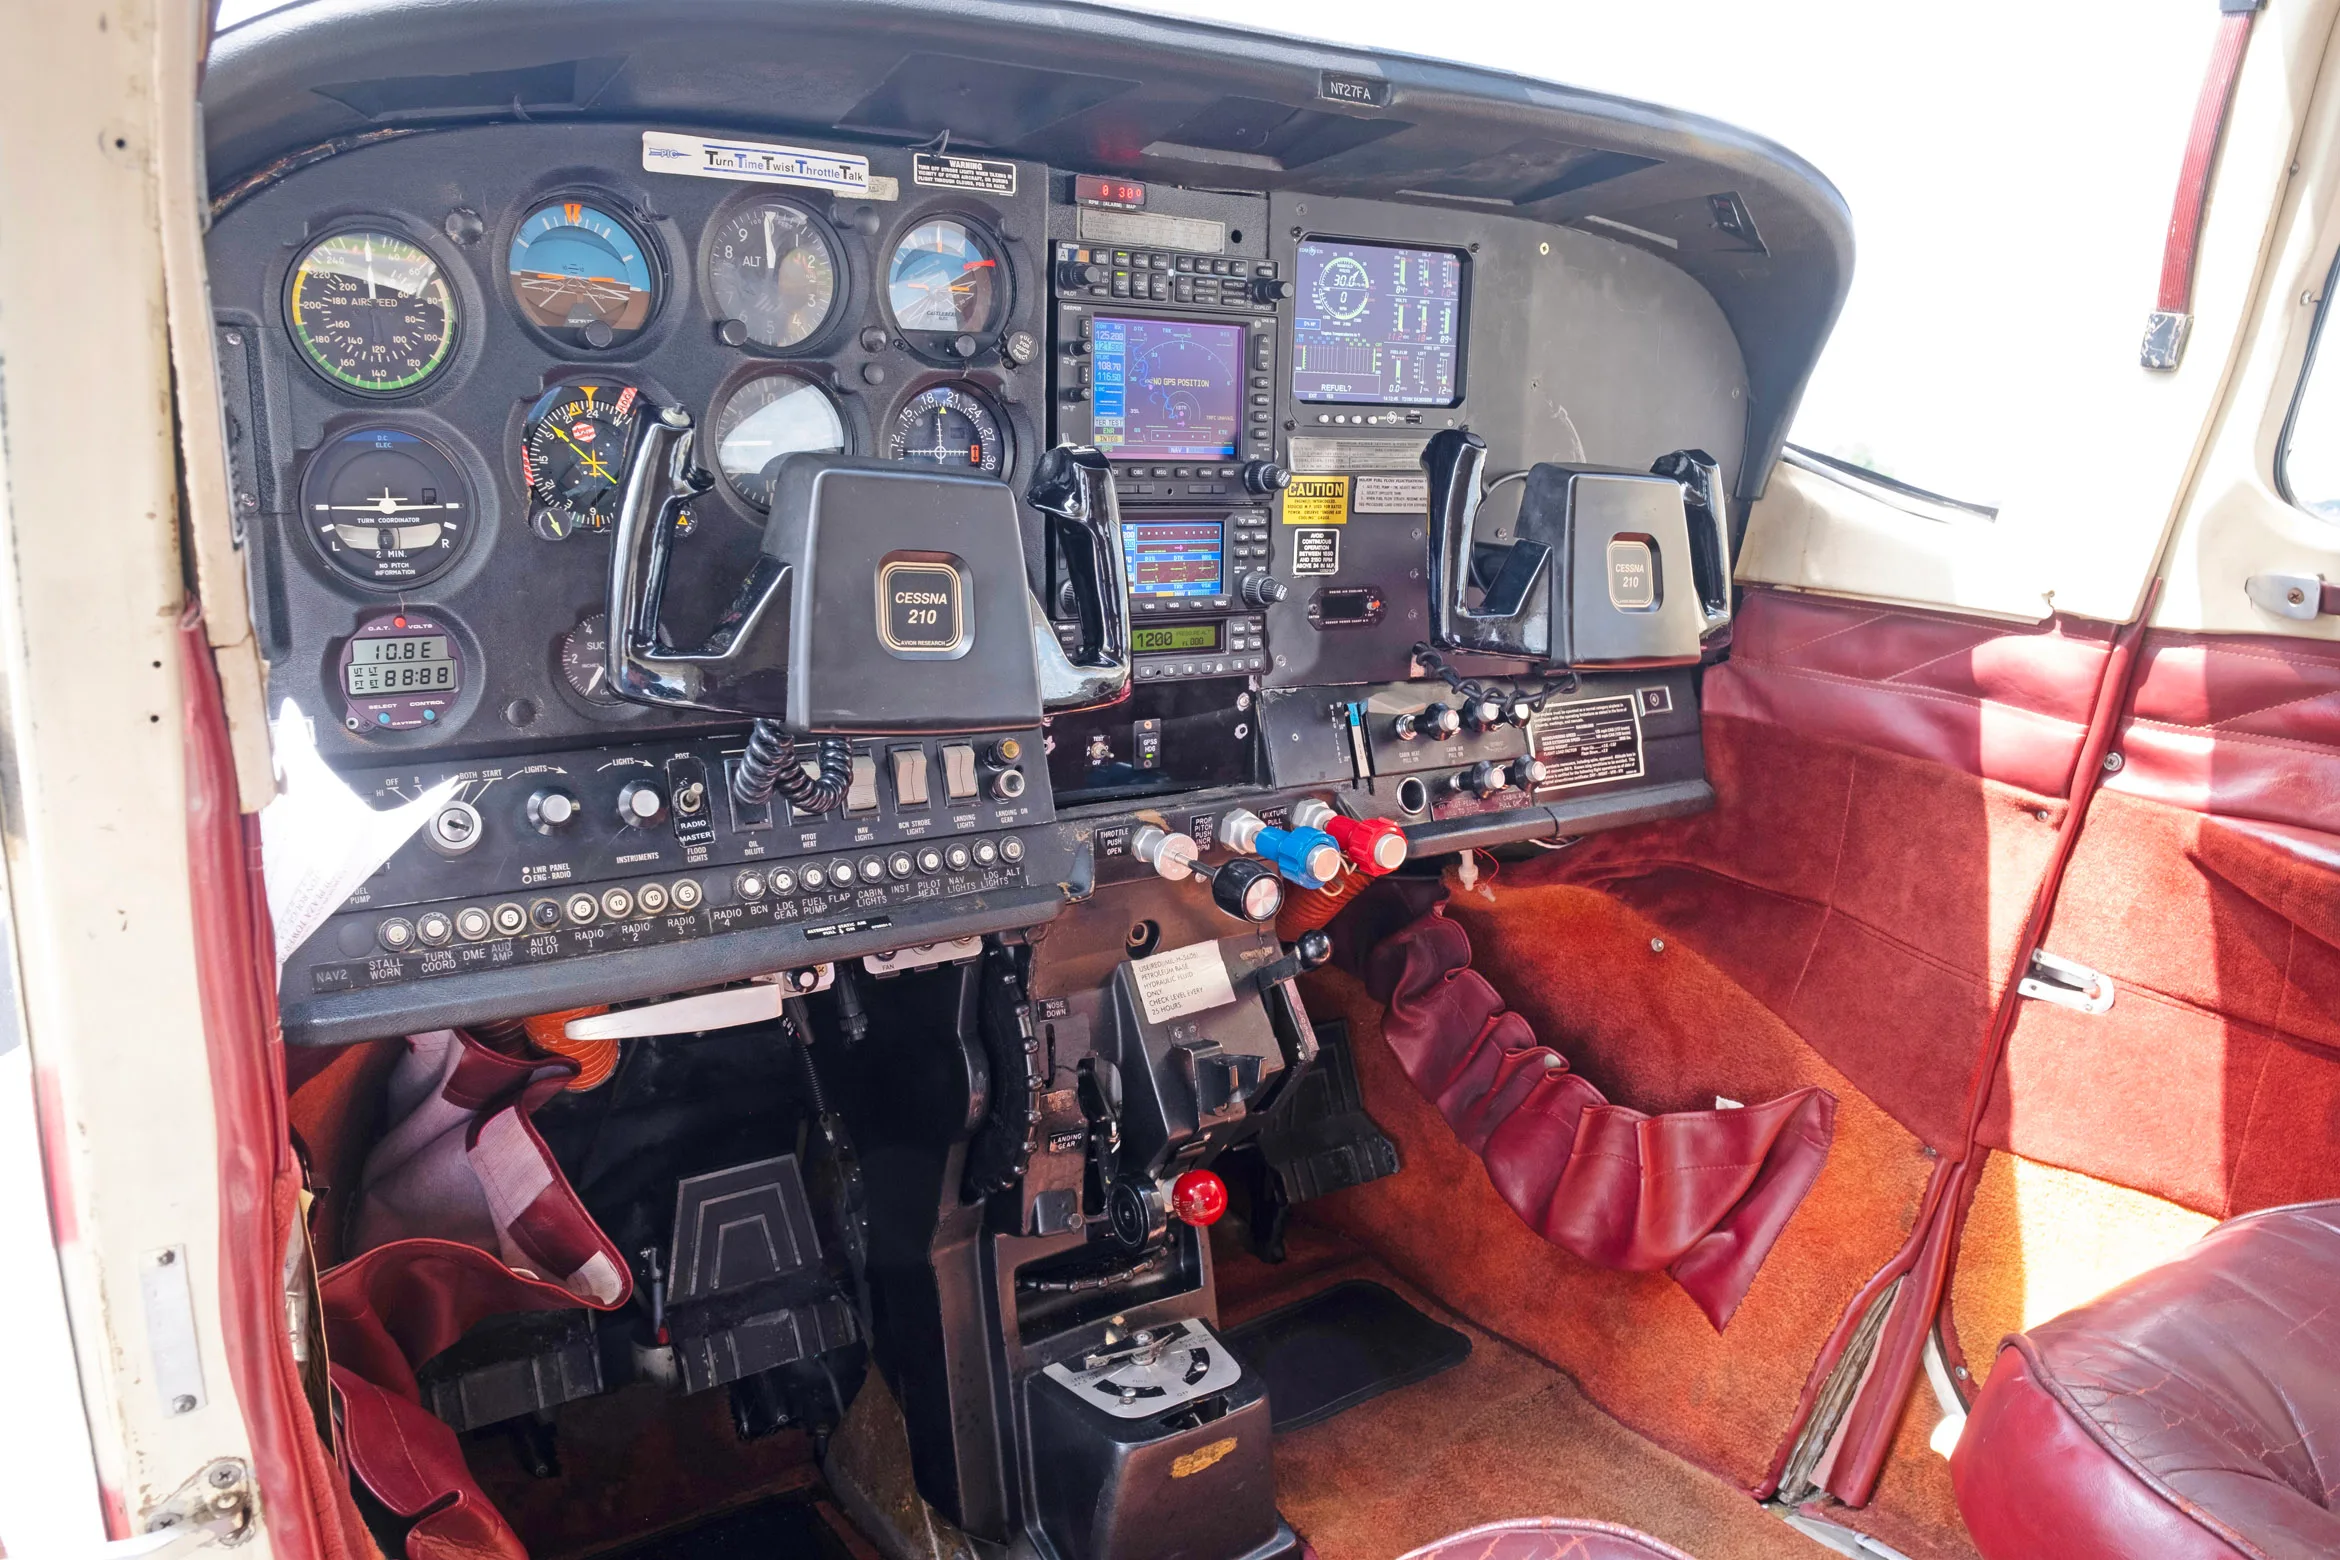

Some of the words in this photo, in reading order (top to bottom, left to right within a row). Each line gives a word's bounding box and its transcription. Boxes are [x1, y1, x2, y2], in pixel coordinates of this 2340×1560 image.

[704, 150, 734, 167] Turn
[734, 153, 764, 170] Time
[762, 156, 795, 173] Twist
[795, 159, 840, 179] Throttle
[839, 164, 863, 182] Talk
[949, 160, 983, 170] WARNING
[738, 228, 748, 242] 9
[725, 245, 733, 259] 8
[326, 256, 344, 264] 240
[742, 256, 761, 267] ALT
[808, 255, 816, 268] 2
[339, 283, 357, 291] 200
[332, 297, 347, 305] 180
[426, 297, 437, 305] 80
[808, 294, 816, 308] 3
[1340, 292, 1347, 303] 0
[303, 301, 322, 309] 200
[335, 320, 350, 328] 160
[404, 316, 416, 324] 80
[792, 313, 802, 326] 4
[315, 336, 330, 344] 180
[348, 336, 363, 345] 140
[393, 336, 407, 344] 100
[424, 334, 438, 342] 100
[1096, 331, 1123, 340] 125.200
[372, 345, 386, 354] 120
[340, 359, 355, 367] 160
[407, 359, 421, 367] 120
[1097, 362, 1121, 370] 108.70
[371, 369, 387, 377] 140
[1097, 372, 1120, 381] 116.50
[1178, 379, 1209, 388] POSITION
[1321, 384, 1352, 392] REFUEL?
[921, 393, 934, 405] 18
[947, 392, 959, 403] 21
[586, 410, 599, 418] 24
[900, 407, 913, 421] 15
[968, 404, 983, 418] 24
[983, 428, 995, 442] 27
[891, 434, 900, 448] 12
[985, 455, 996, 470] 30
[1289, 483, 1343, 496] CAUTION
[332, 542, 340, 551] L
[442, 539, 449, 548] R
[388, 550, 407, 558] MIN.
[1616, 564, 1644, 573] CESSNA
[1623, 576, 1639, 588] 210
[895, 592, 947, 604] CESSNA
[908, 610, 937, 624] 210
[586, 625, 592, 634] 4
[1137, 632, 1173, 648] 1200
[572, 654, 578, 664] 2
[612, 758, 635, 766] LIGHTS
[482, 769, 502, 778] START
[524, 765, 547, 774] LIGHTS
[459, 771, 478, 779] BOTH
[385, 778, 399, 786] OFF
[995, 808, 1018, 817] LANDING
[1262, 808, 1287, 818] MIXTURE
[911, 818, 931, 828] STROBE
[953, 814, 976, 823] LANDING
[1001, 815, 1014, 823] GEAR
[1196, 817, 1212, 825] PROP
[680, 820, 706, 829] RADIO
[957, 821, 975, 829] LIGHTS
[906, 827, 925, 835] LIGHTS
[1100, 828, 1129, 838] THROTTLE
[679, 831, 712, 842] MASTER
[801, 832, 817, 841] PITOT
[854, 833, 874, 842] LIGHTS
[1107, 837, 1122, 846] PUSH
[803, 840, 817, 848] HEAT
[687, 847, 707, 855] FLOOD
[744, 847, 765, 856] DILUTE
[1107, 846, 1122, 855] OPEN
[616, 852, 659, 864] INSTRUMENTS
[687, 854, 708, 863] LIGHTS
[533, 865, 547, 874] LWR
[550, 863, 570, 871] PANEL
[1005, 868, 1021, 876] ALT
[533, 873, 546, 882] ENG
[552, 871, 571, 880] RADIO
[948, 876, 965, 885] NAV
[983, 872, 999, 880] LDG
[917, 879, 941, 890] PILOT
[947, 882, 976, 893] LIGHTS
[980, 877, 1009, 889] LIGHTS
[858, 888, 883, 899] CABIN
[891, 884, 910, 894] INST
[350, 895, 371, 904] PUMP
[802, 898, 825, 907] FUEL
[828, 893, 850, 903] FLAP
[856, 896, 888, 908] LIGHTS
[751, 905, 769, 915] BCN
[776, 901, 794, 910] LDG
[803, 905, 828, 915] PUMP
[714, 908, 742, 920] RADIO
[774, 909, 798, 920] GEAR
[667, 916, 695, 927] RADIO
[621, 923, 650, 934] RADIO
[807, 926, 836, 934] ALTERNATE
[575, 929, 604, 941] RADIO
[491, 941, 512, 952] AUD
[531, 936, 556, 947] AUTO
[463, 948, 486, 961] DME
[531, 944, 559, 956] PILOT
[424, 950, 452, 961] TURN
[492, 951, 513, 962] AMP
[369, 958, 404, 971] STALL
[421, 959, 456, 972] COORD
[882, 963, 895, 971] FAN
[316, 969, 348, 983] NAV2
[370, 968, 401, 980] WORN
[1141, 967, 1174, 980] PETROLEUM
[1175, 963, 1189, 972] BASE
[1144, 975, 1177, 989] HYDRAULIC
[1178, 972, 1193, 980] FLUID
[1146, 989, 1162, 998] ONLY
[1149, 996, 1169, 1007] CHECK
[1170, 992, 1186, 1001] LEVEL
[1187, 987, 1203, 996] EVERY
[1046, 1000, 1064, 1009] NOSE
[1046, 1008, 1067, 1018] DOWN
[1053, 1133, 1082, 1145] LANDING
[1058, 1140, 1076, 1150] GEAR
